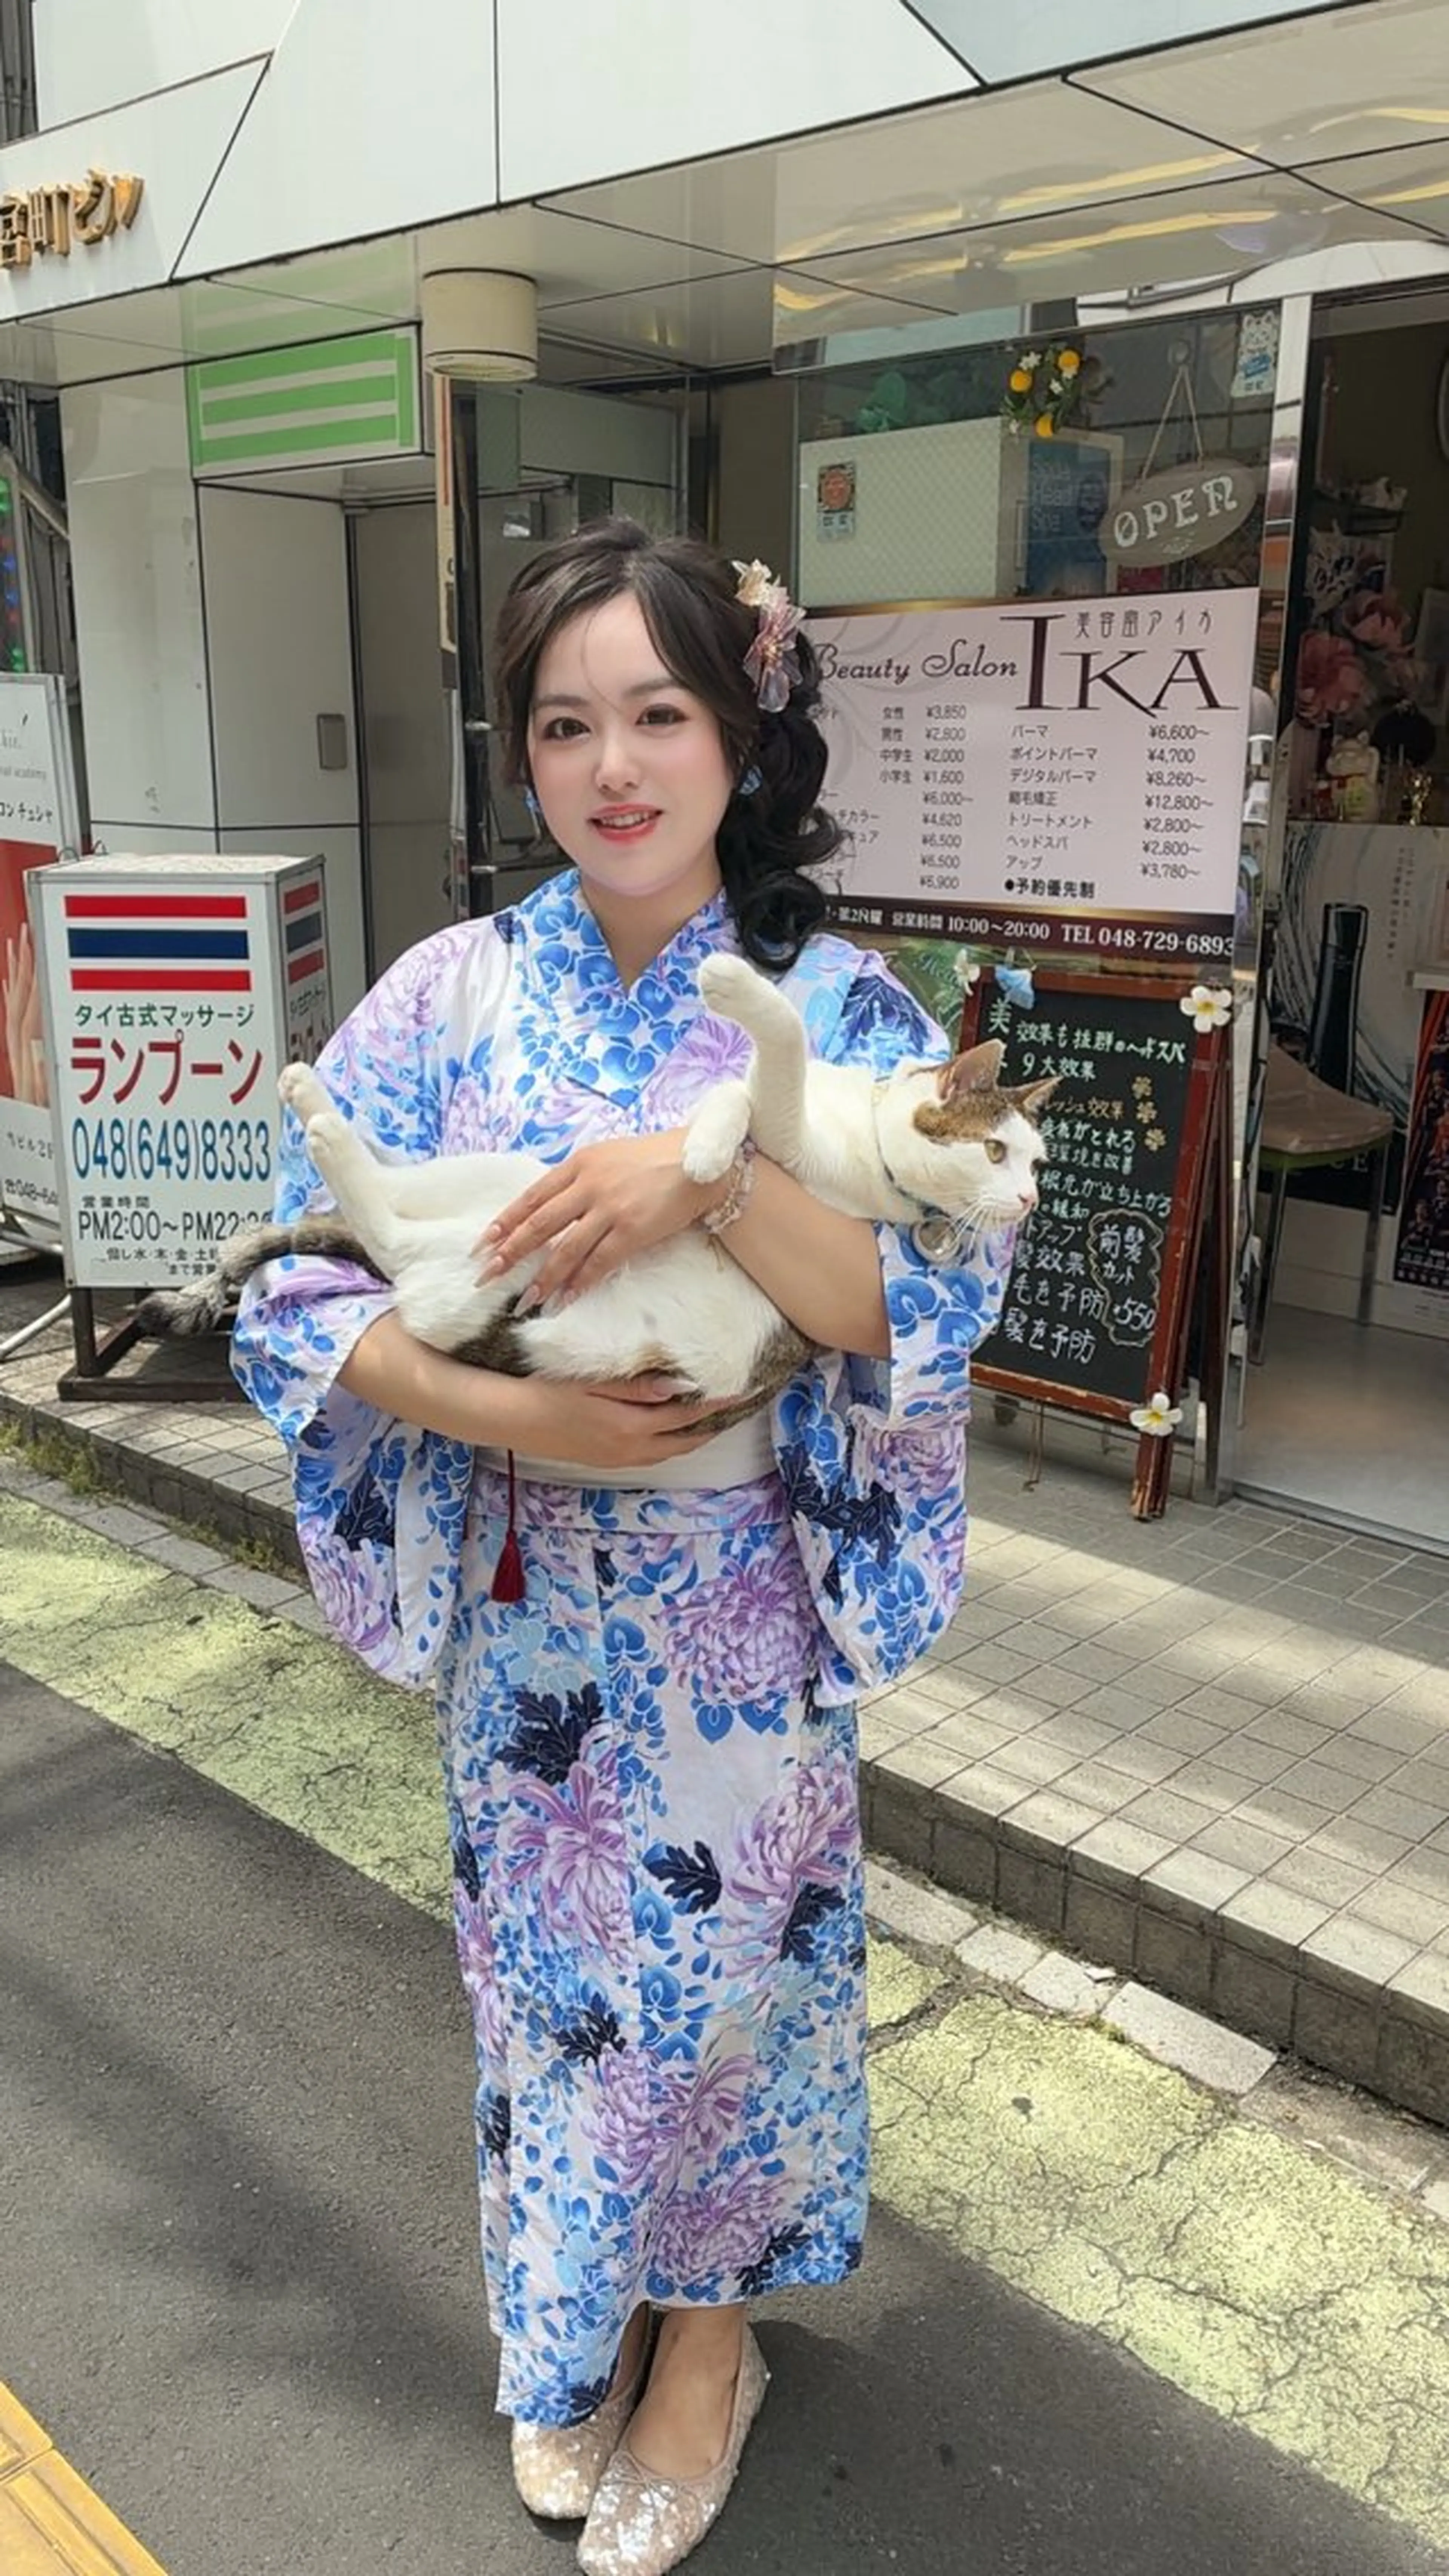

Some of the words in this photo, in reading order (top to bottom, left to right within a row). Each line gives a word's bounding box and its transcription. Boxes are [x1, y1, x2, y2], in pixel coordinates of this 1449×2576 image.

[1114, 476, 1238, 547] OPEN
[815, 643, 909, 684] Beauty
[922, 638, 1018, 678] Salon
[1000, 614, 1239, 718] IKA
[1061, 924, 1094, 944] TEL
[75, 1004, 255, 1028] タイ古式マッサージ
[70, 1029, 264, 1106] ランプーン
[72, 1117, 271, 1181] 048(649)8333
[82, 1195, 150, 1209] 営業時間
[1099, 1224, 1145, 1264] 前髪
[996, 1307, 1096, 1364] 髪を予防
